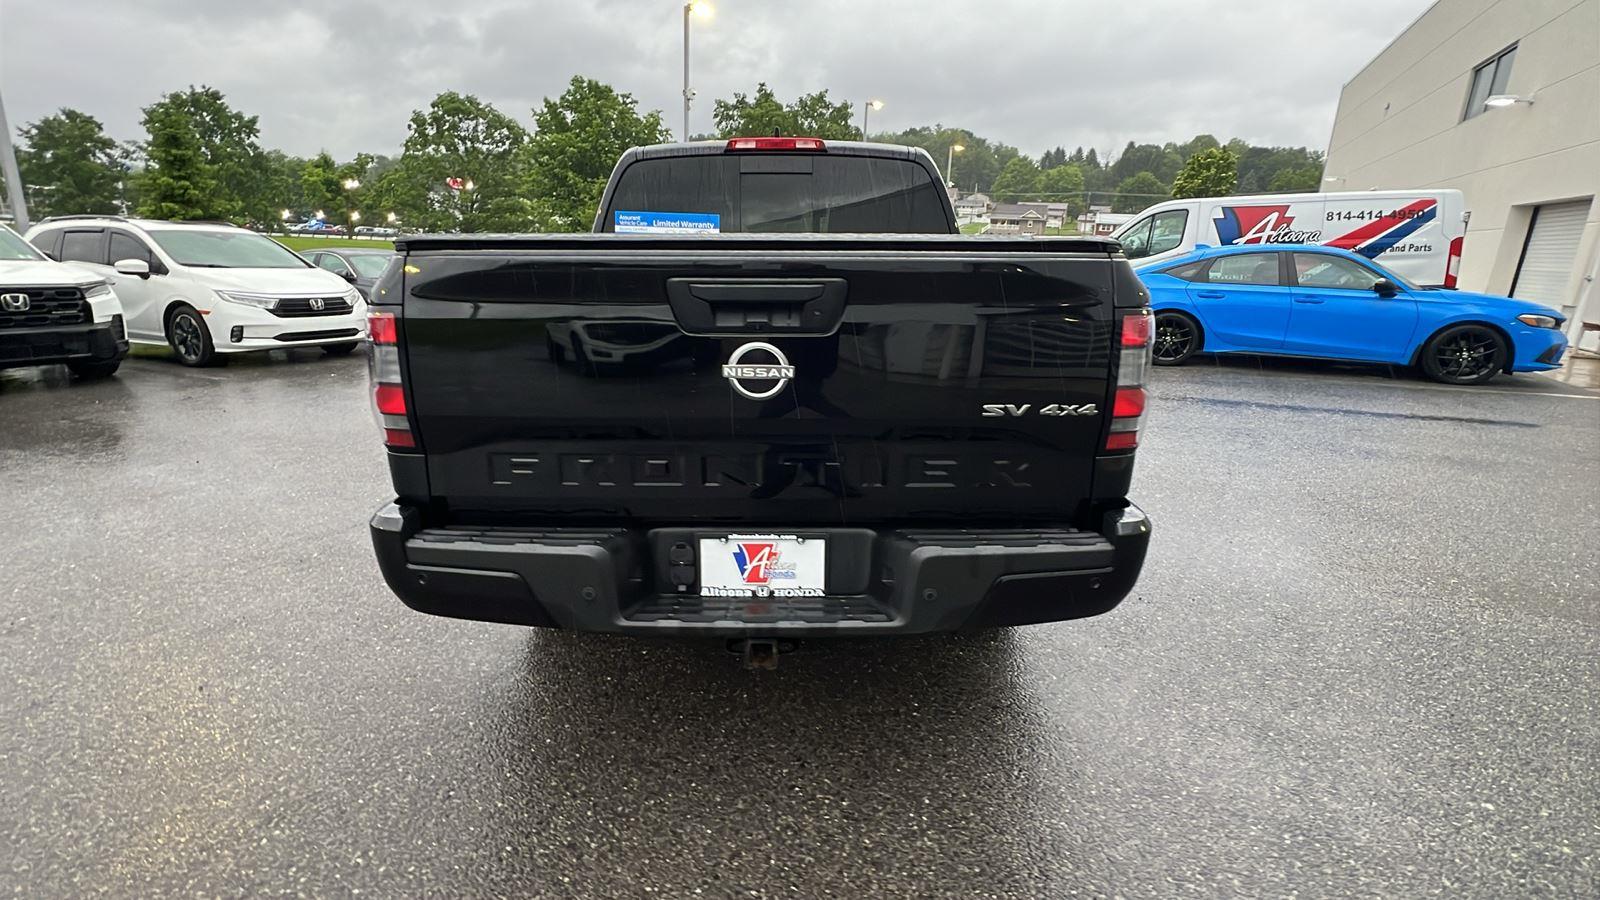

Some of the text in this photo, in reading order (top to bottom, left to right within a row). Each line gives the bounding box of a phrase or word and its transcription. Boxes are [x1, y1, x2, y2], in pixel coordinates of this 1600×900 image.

[1326, 209, 1425, 221] 814-414-4950
[652, 219, 715, 230] Limited Warranty
[1232, 211, 1321, 245] Altoona
[1389, 244, 1407, 253] and
[1408, 243, 1432, 252] Parts
[723, 367, 794, 378] NISSAN
[982, 403, 1031, 416] SV
[488, 453, 1033, 488] FRONTIER
[700, 587, 826, 597] Altoona HONDA
